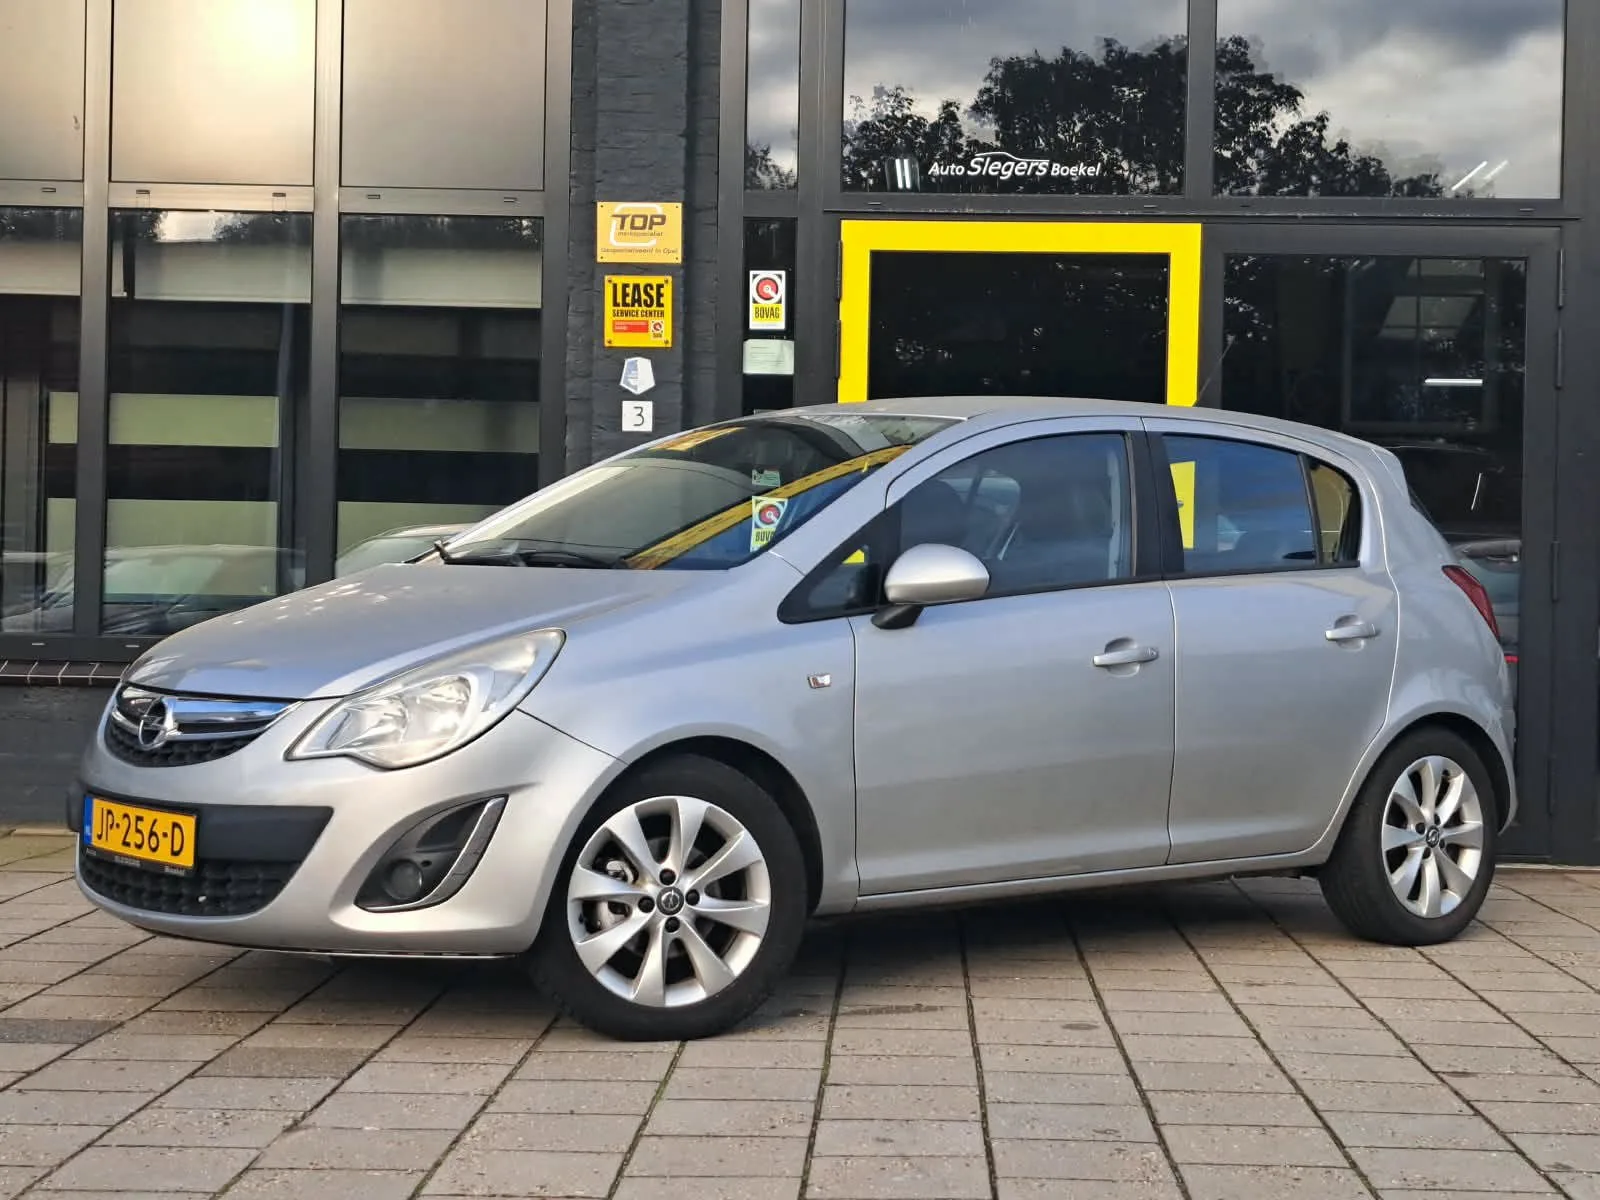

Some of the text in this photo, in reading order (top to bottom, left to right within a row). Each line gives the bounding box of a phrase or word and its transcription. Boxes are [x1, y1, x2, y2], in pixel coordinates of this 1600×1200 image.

[928, 157, 1101, 180] Auto Slegers Boekel
[611, 214, 667, 230] TOP
[612, 283, 665, 308] LEASE
[612, 309, 665, 318] SERVICE CENTER
[754, 306, 780, 319] BOVAG
[632, 406, 645, 427] 3
[96, 807, 185, 857] JP-256-D
